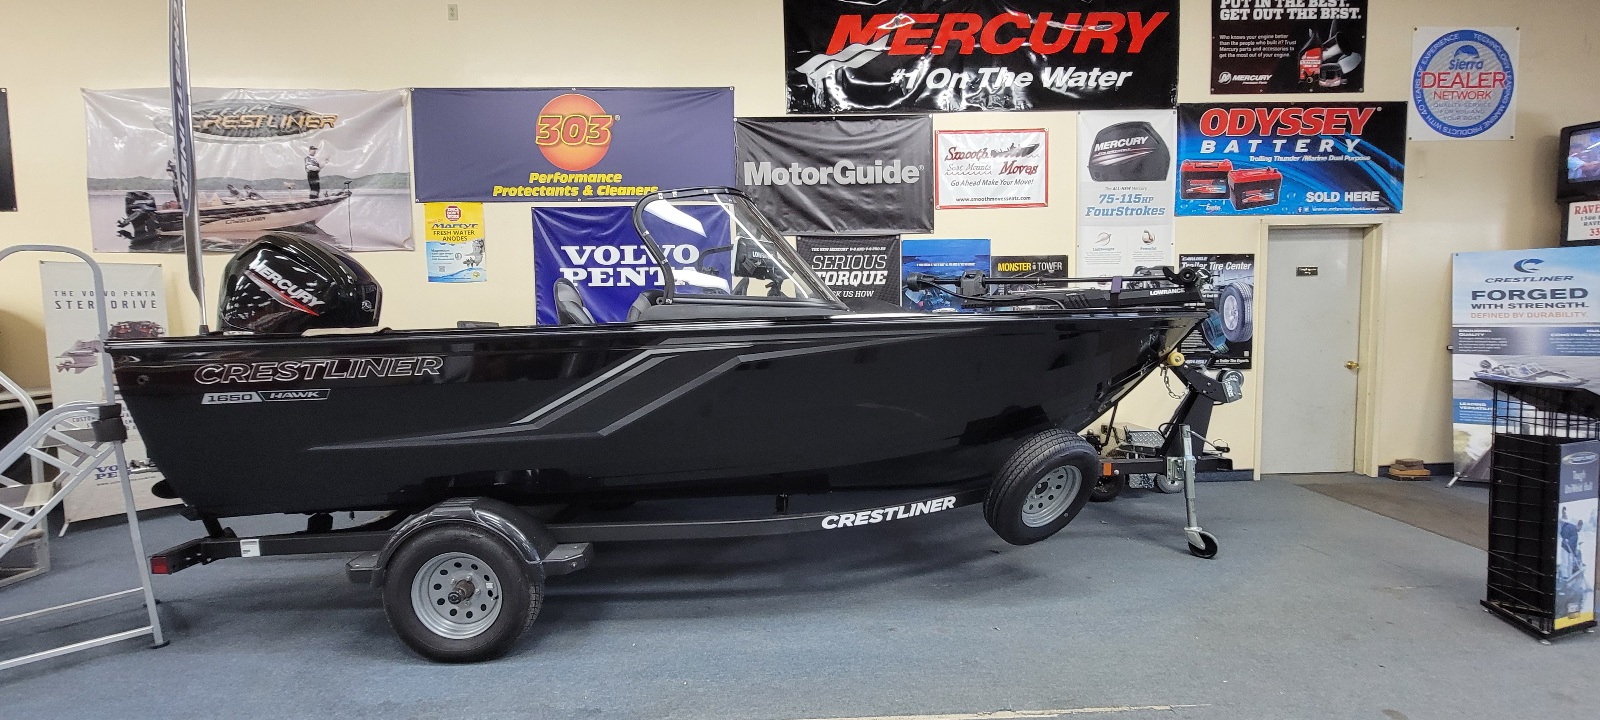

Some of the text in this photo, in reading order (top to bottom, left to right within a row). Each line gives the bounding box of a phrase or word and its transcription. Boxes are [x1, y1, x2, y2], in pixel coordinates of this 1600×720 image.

[1220, 8, 1362, 20] GET OUT THE BEST.
[826, 12, 1169, 55] MERCURY
[1449, 59, 1483, 70] Sierra
[891, 67, 1132, 89] #1 On The Water
[1422, 72, 1506, 88] DEALER
[1433, 91, 1492, 100] NETWORK
[536, 114, 614, 145] 303
[1200, 108, 1376, 137] ODYSSEY
[1095, 136, 1148, 152] MERCURY
[1200, 139, 1361, 154] BATTERY
[944, 146, 988, 161] Smooth
[744, 160, 920, 186] MotorGuide
[947, 163, 991, 172] Seat Mounts
[998, 160, 1039, 175] Moves
[529, 172, 622, 184] Performance
[493, 185, 658, 196] Protectants & Cleaners
[1305, 191, 1380, 202] SOLD HERE
[1085, 206, 1165, 217] FourStrokes
[561, 244, 699, 265] VOLVO
[812, 255, 887, 270] SERIOUS
[997, 262, 1031, 272] MONSTER
[1037, 262, 1063, 271] TOWER
[1181, 262, 1252, 270] Trailer Tire Center
[249, 258, 325, 306] MERCURY
[815, 270, 888, 287] TORQUE
[1485, 275, 1574, 283] CRESTLINER
[1471, 288, 1588, 300] FORGED
[56, 300, 157, 309] STERDRIVE
[194, 356, 443, 384] CRESTLINER
[207, 391, 320, 403] 1650 HAWK
[821, 496, 956, 530] CRESTLINER
